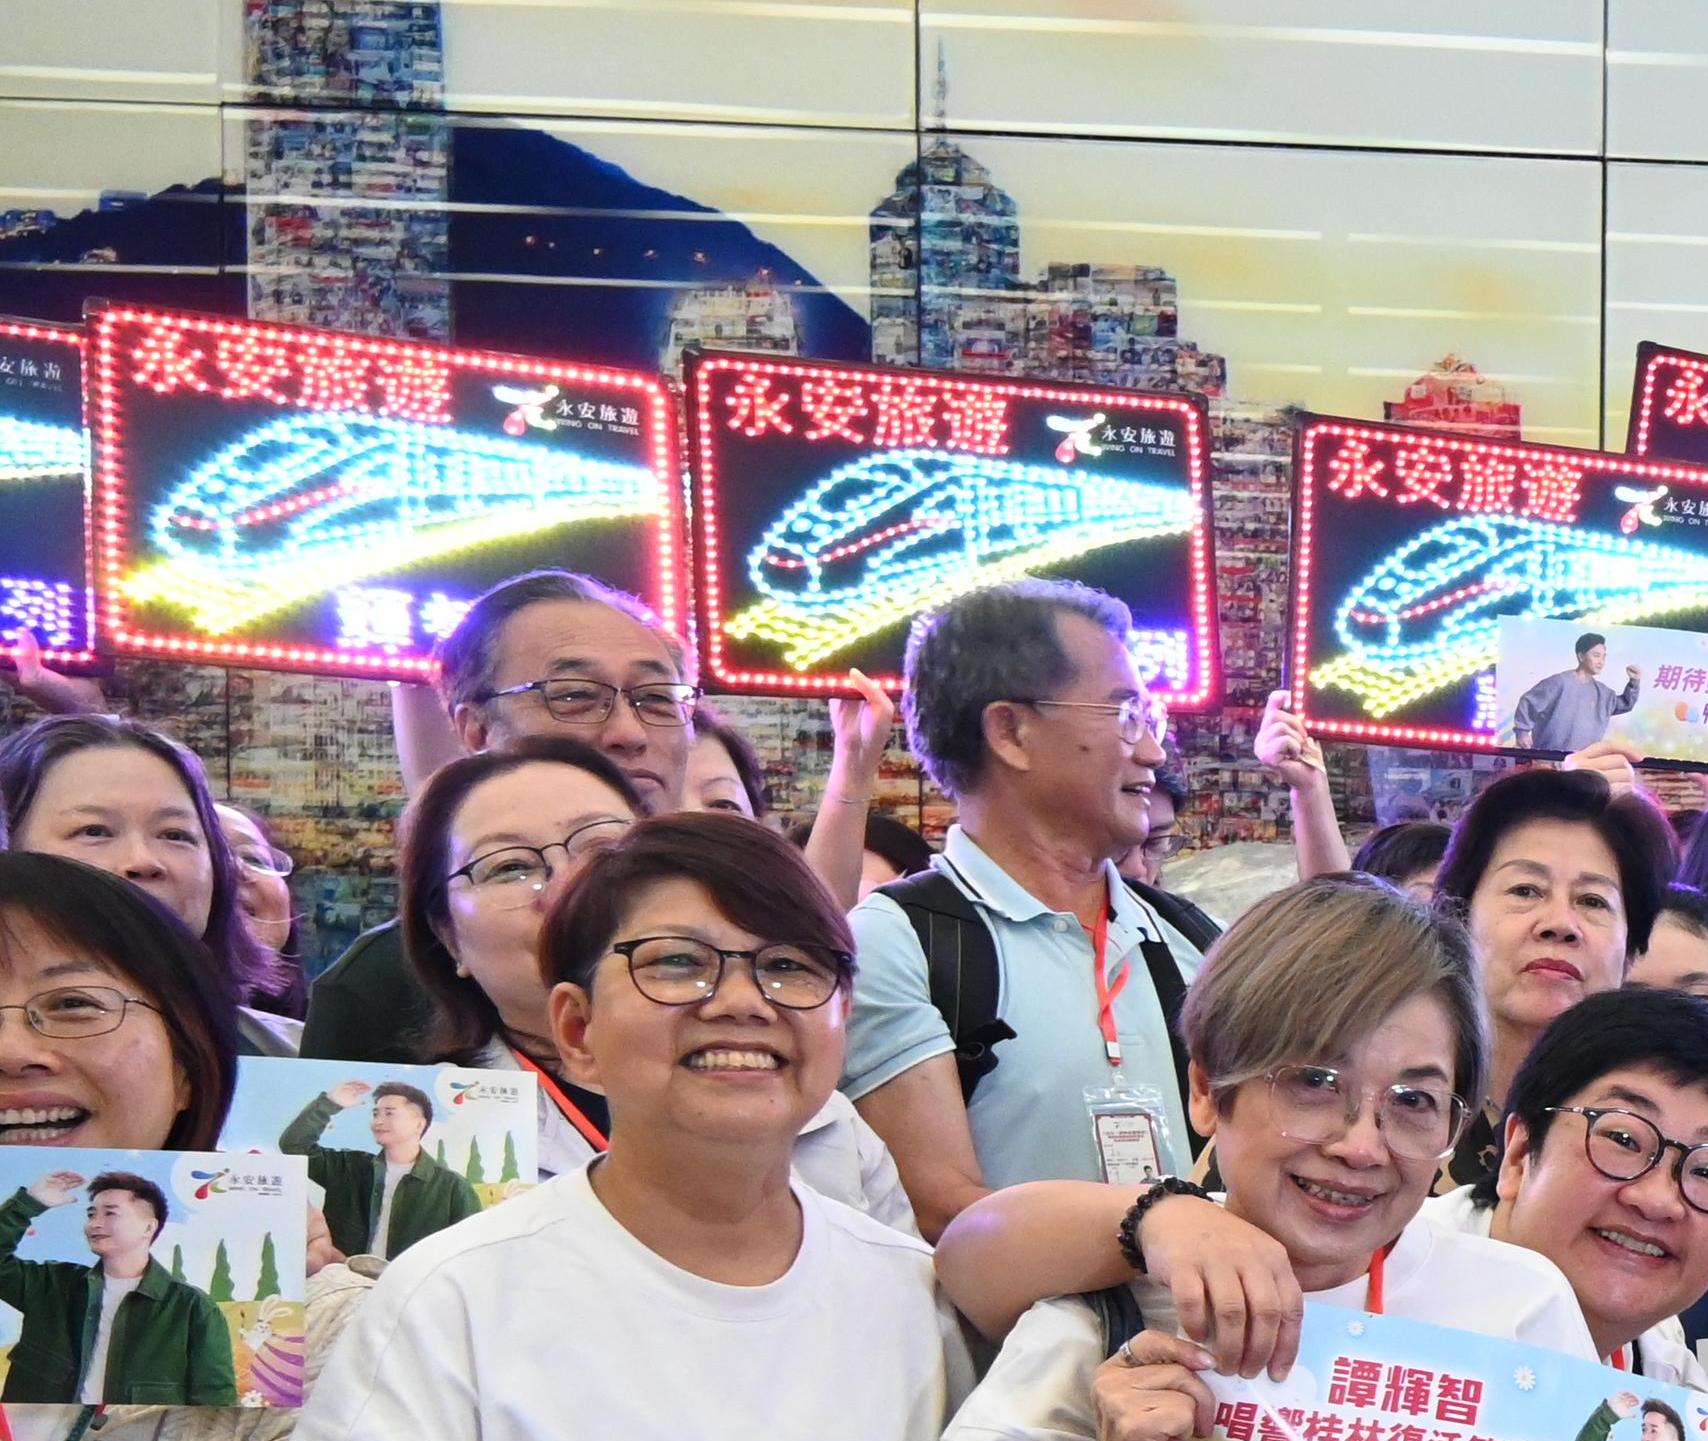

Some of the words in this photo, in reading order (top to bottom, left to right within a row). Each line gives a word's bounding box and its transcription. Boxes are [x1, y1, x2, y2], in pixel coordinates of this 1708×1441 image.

[131, 322, 453, 423] 永安旅遊
[587, 421, 603, 431] ON
[725, 371, 1012, 455] 永安旅遊
[1130, 446, 1143, 455] ON
[1147, 447, 1176, 457] TRAVEL
[1328, 438, 1583, 520] 永安旅遊
[1688, 517, 1700, 526] ON
[1327, 1356, 1485, 1427] 譚輝智
